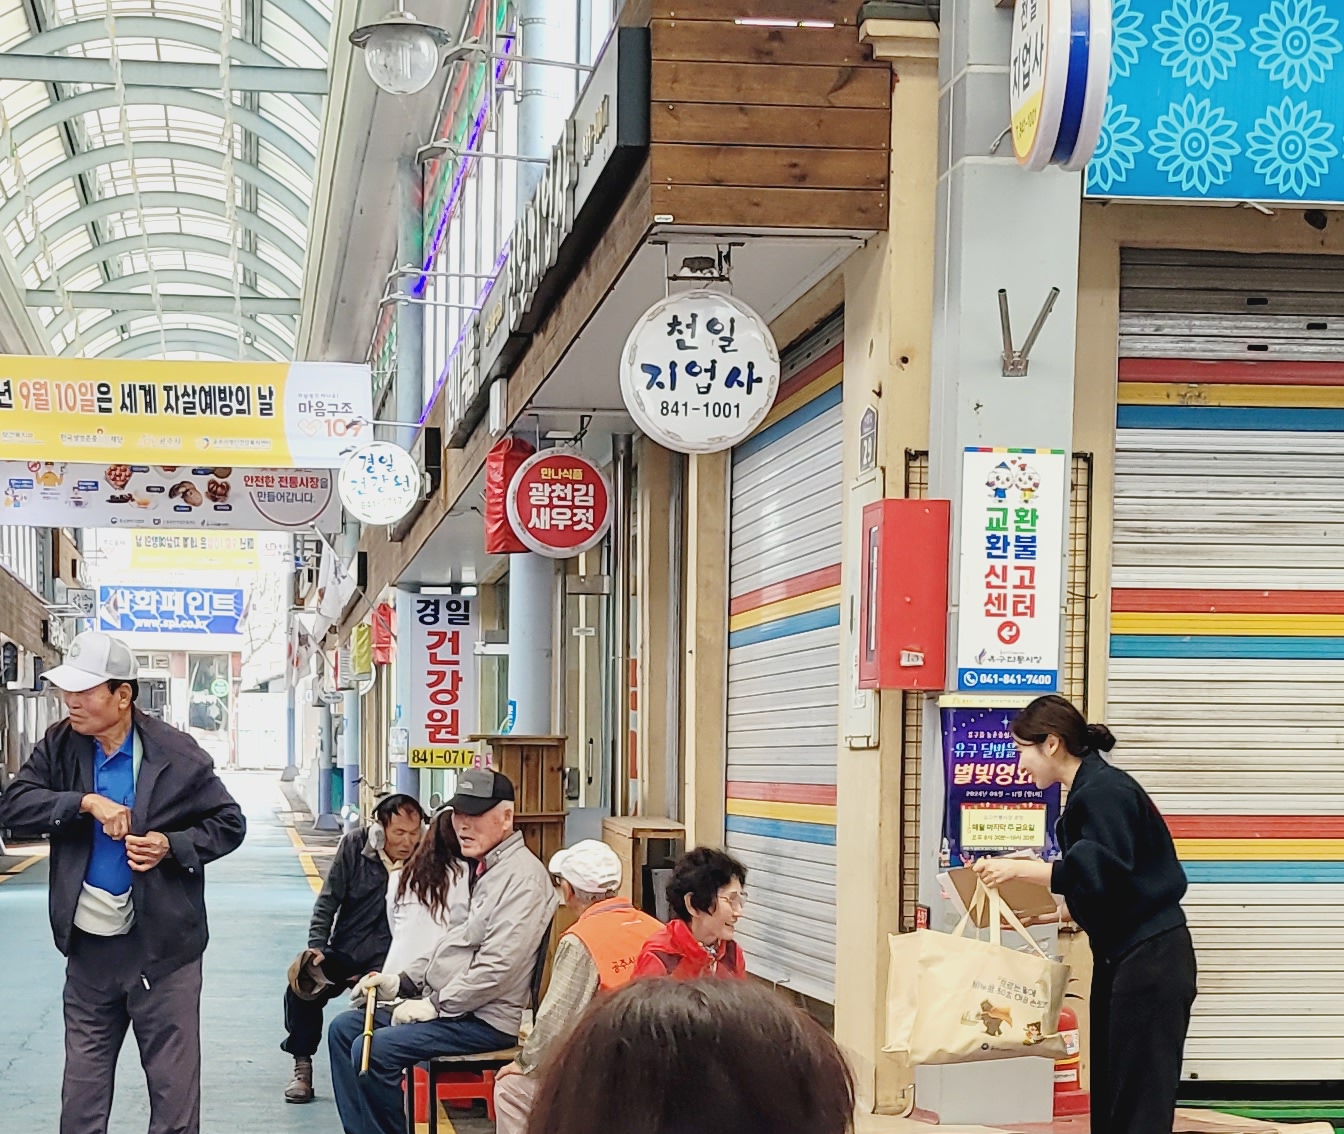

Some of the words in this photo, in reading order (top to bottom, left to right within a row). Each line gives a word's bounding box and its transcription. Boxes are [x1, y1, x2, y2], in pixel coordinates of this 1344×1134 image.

[667, 312, 738, 353] 천일
[640, 359, 763, 395] 지업사
[19, 380, 50, 411] 9월
[55, 381, 113, 414] 10일은
[119, 382, 157, 414] 세계
[162, 384, 252, 417] 자살예방의
[258, 386, 274, 417] 날
[298, 401, 353, 417] 마음구조
[660, 400, 740, 418] 841-1001
[60, 433, 123, 444] 한국생명존중재단
[358, 453, 397, 474] 경일
[243, 475, 275, 488] 안전한
[278, 476, 328, 489] 전통시장을
[528, 482, 595, 506] 광천김
[528, 507, 595, 531] 새우젓
[985, 507, 1039, 533] 교환
[985, 534, 1037, 560] 환불
[984, 564, 1036, 590] 신고
[416, 599, 470, 626] 경일
[984, 592, 1035, 618] 센터
[425, 630, 463, 745] 건강원
[979, 672, 1052, 685] 041-841-7400
[412, 749, 474, 764] 841-0717
[954, 742, 978, 758] 유구
[611, 955, 636, 974] 공주시
